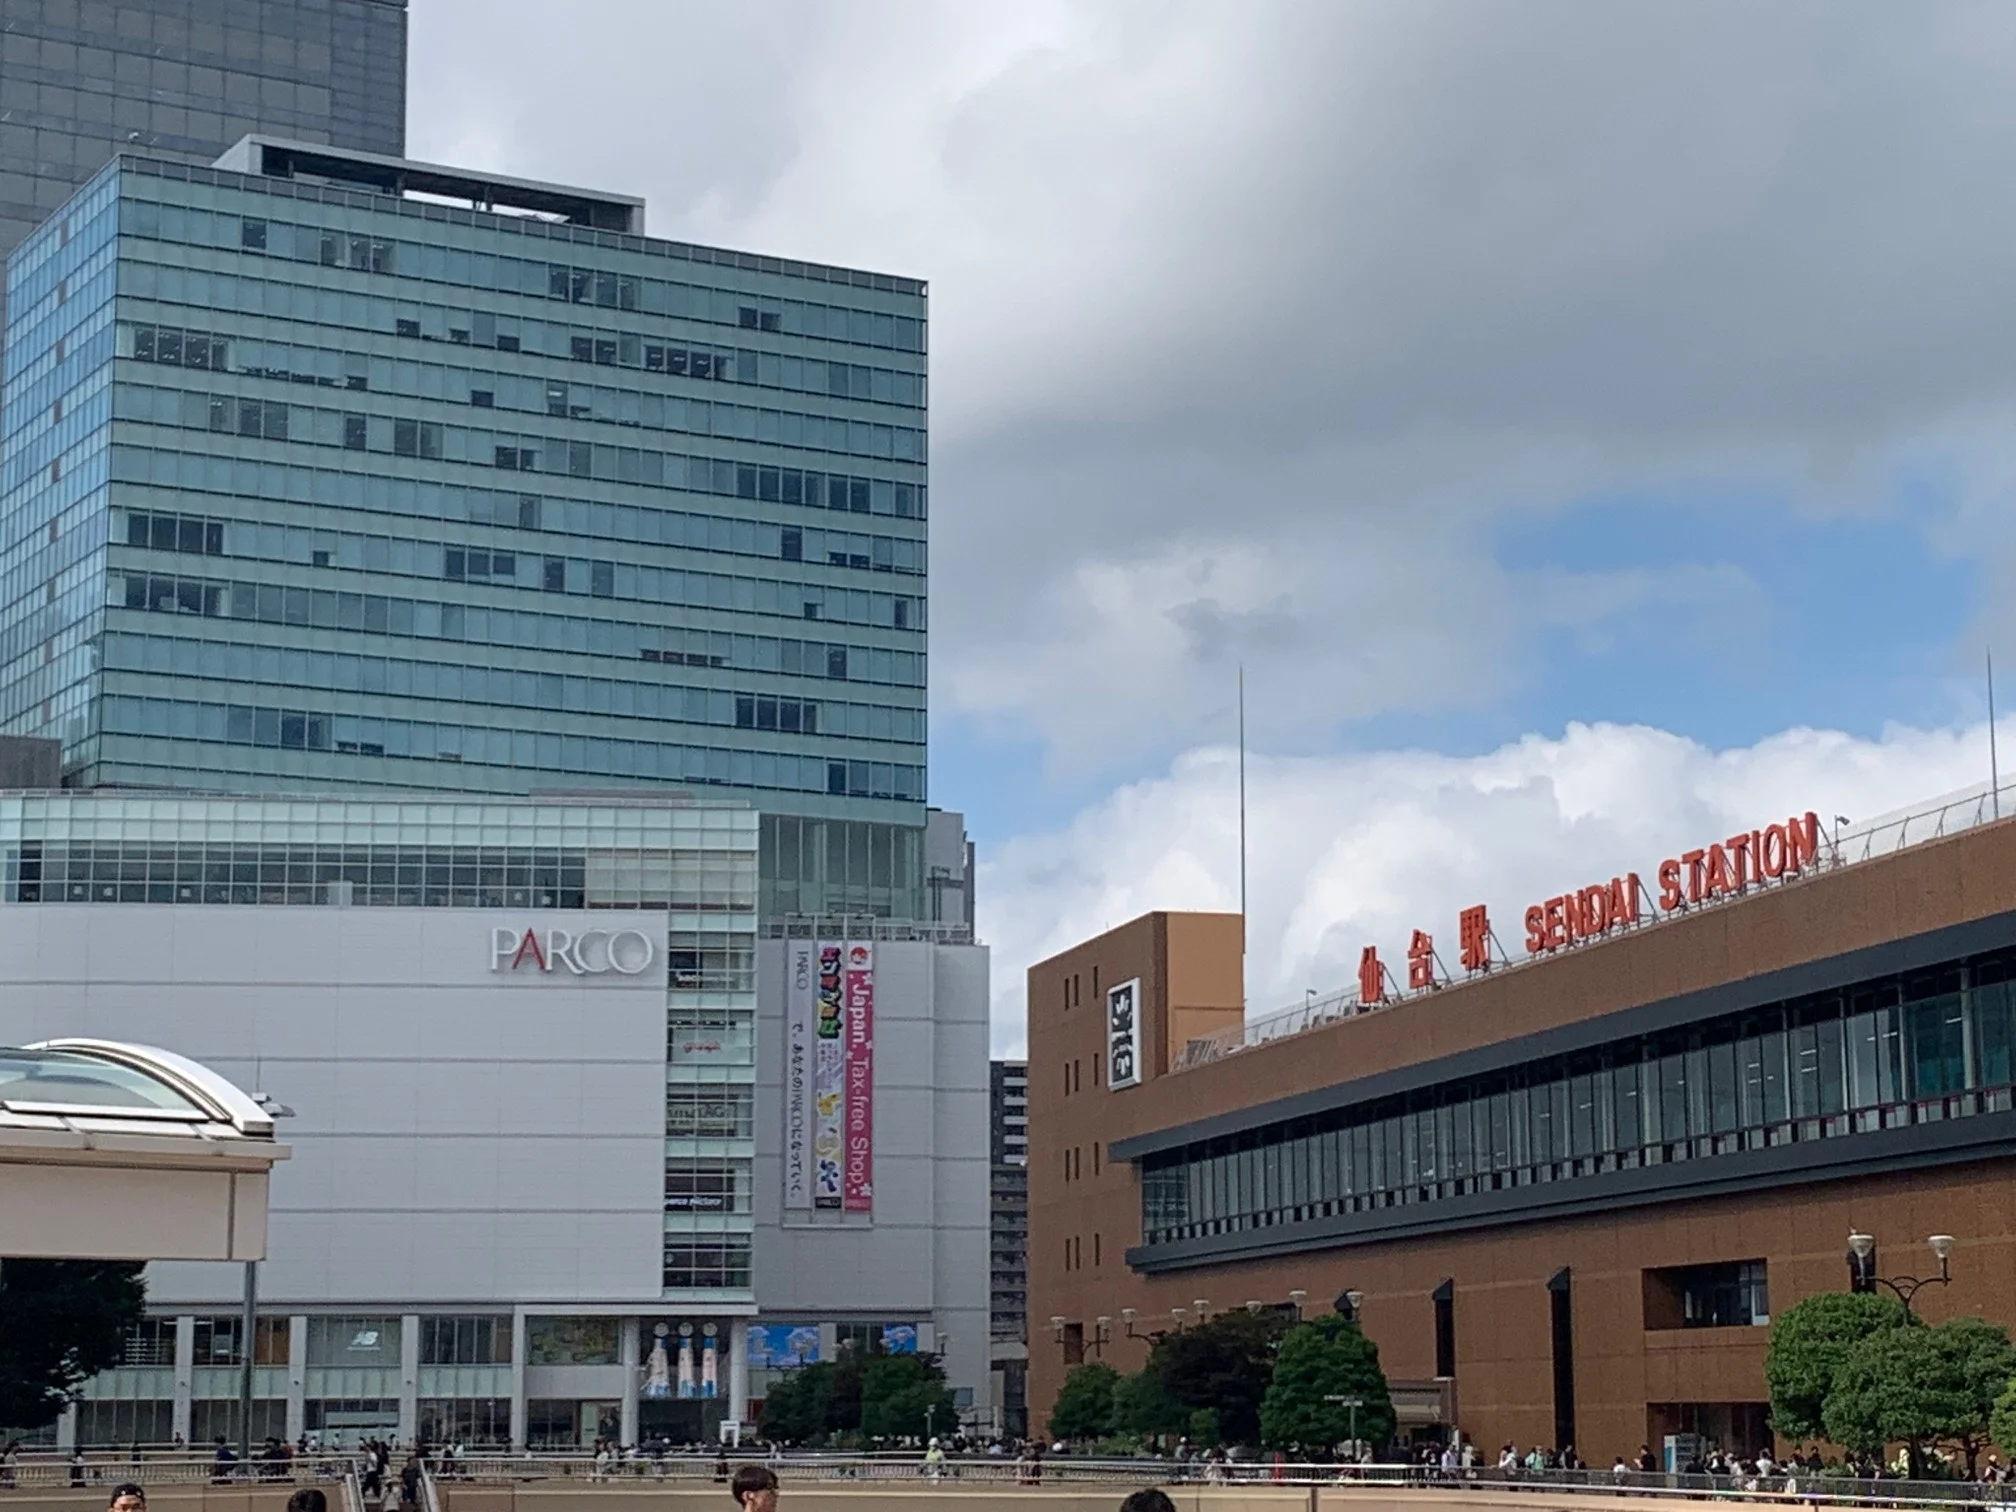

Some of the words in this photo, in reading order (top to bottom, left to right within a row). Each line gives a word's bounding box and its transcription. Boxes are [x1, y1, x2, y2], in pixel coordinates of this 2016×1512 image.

[1525, 872, 1638, 953] SENDAI
[1658, 811, 1818, 912] STATION
[491, 927, 653, 974] PARCO
[849, 984, 870, 1049] Japan.
[851, 1057, 869, 1130] Tax-free
[848, 1137, 869, 1183] Shop
